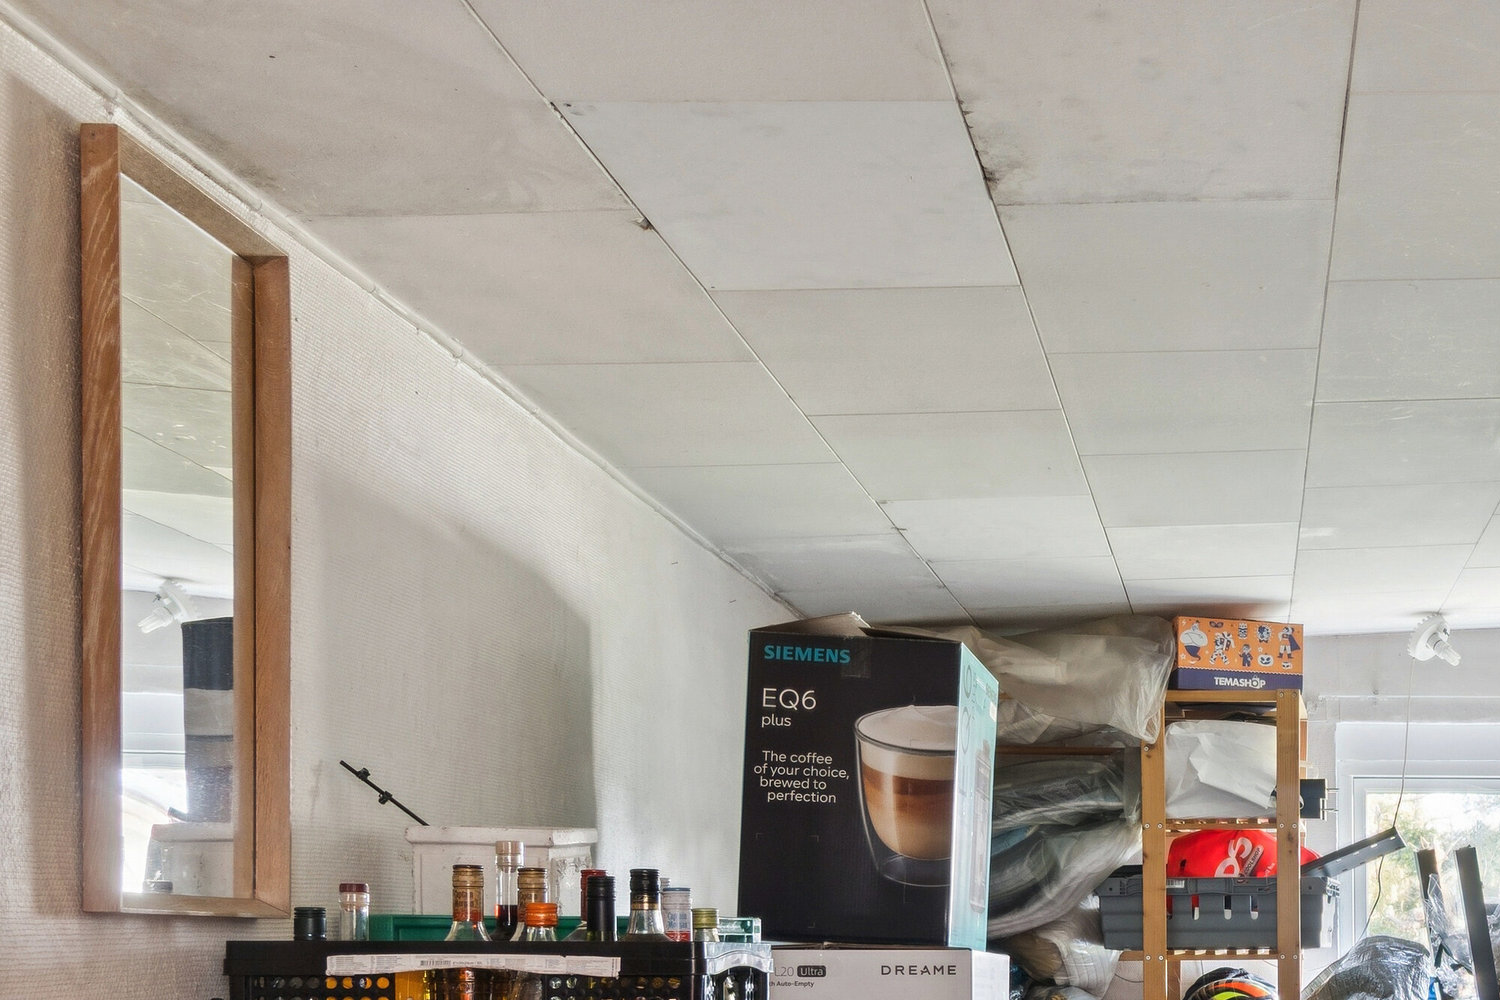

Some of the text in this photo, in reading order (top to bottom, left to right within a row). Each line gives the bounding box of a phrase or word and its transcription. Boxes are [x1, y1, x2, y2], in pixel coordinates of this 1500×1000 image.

[764, 645, 851, 664] SIEMENS
[1214, 675, 1266, 689] TEMASHOP
[762, 687, 817, 711] EQ6
[761, 713, 792, 728] plus
[762, 750, 833, 765] The coffee
[753, 763, 850, 780] of your choice,
[760, 776, 827, 790] brewed to
[767, 790, 836, 803] perfection
[800, 966, 824, 976] Ultra
[881, 965, 957, 976] DREAME
